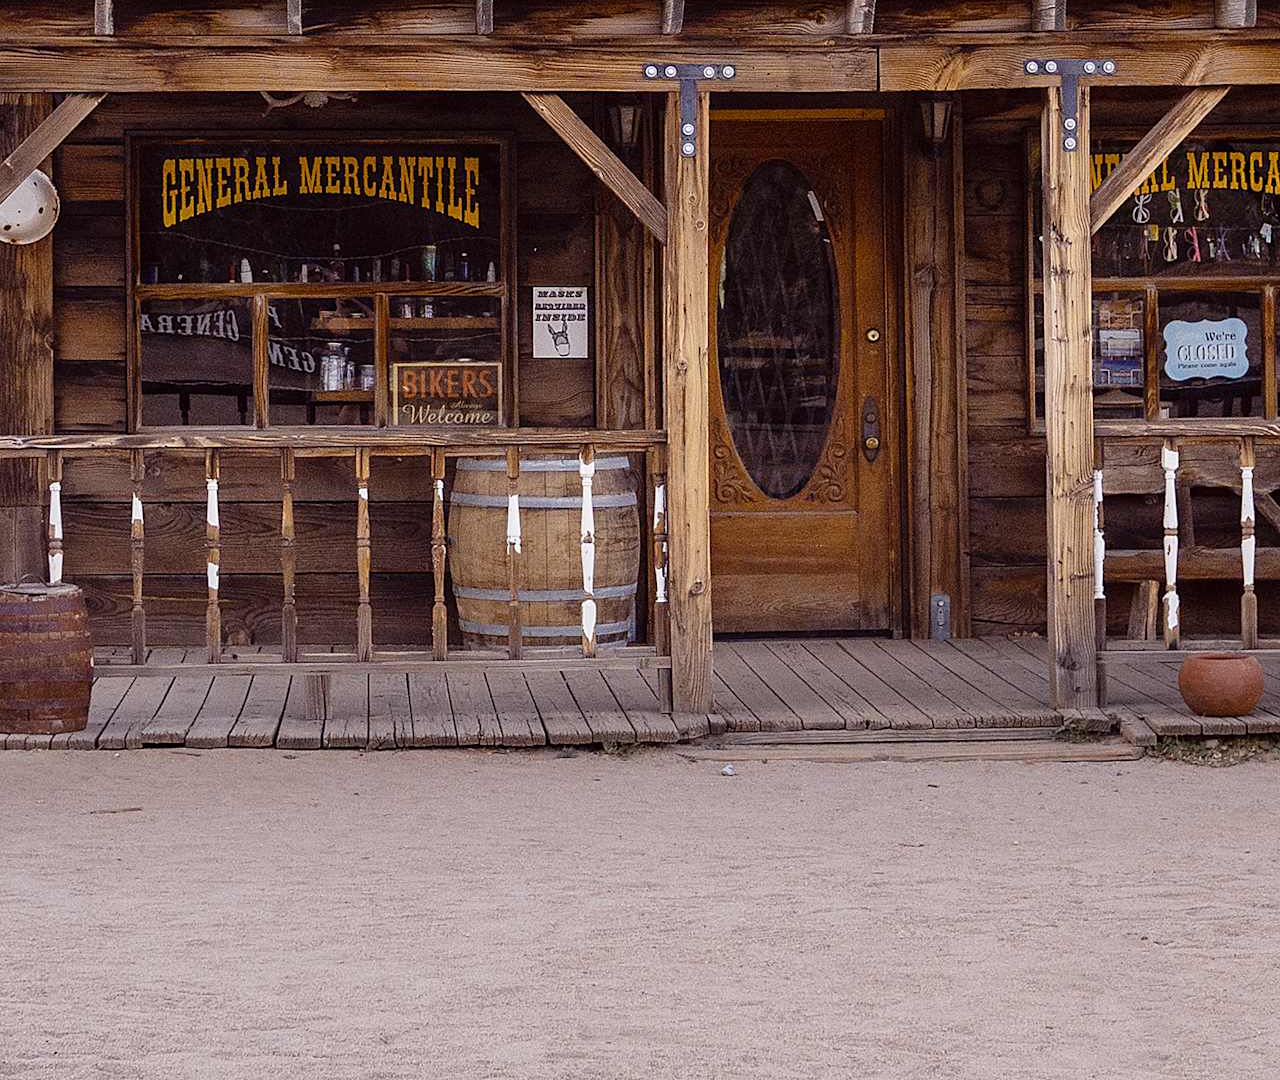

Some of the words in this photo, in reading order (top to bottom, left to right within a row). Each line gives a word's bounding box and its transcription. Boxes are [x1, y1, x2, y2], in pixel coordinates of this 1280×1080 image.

[162, 156, 288, 228] GENERAL
[299, 156, 480, 229] MERCANTILE
[537, 290, 583, 298] MASKS
[535, 313, 586, 322] INSIDE
[1205, 332, 1237, 341] We're
[1177, 343, 1236, 361] CLOSED
[402, 370, 493, 399] BIKERS
[402, 403, 494, 424] Welcome
